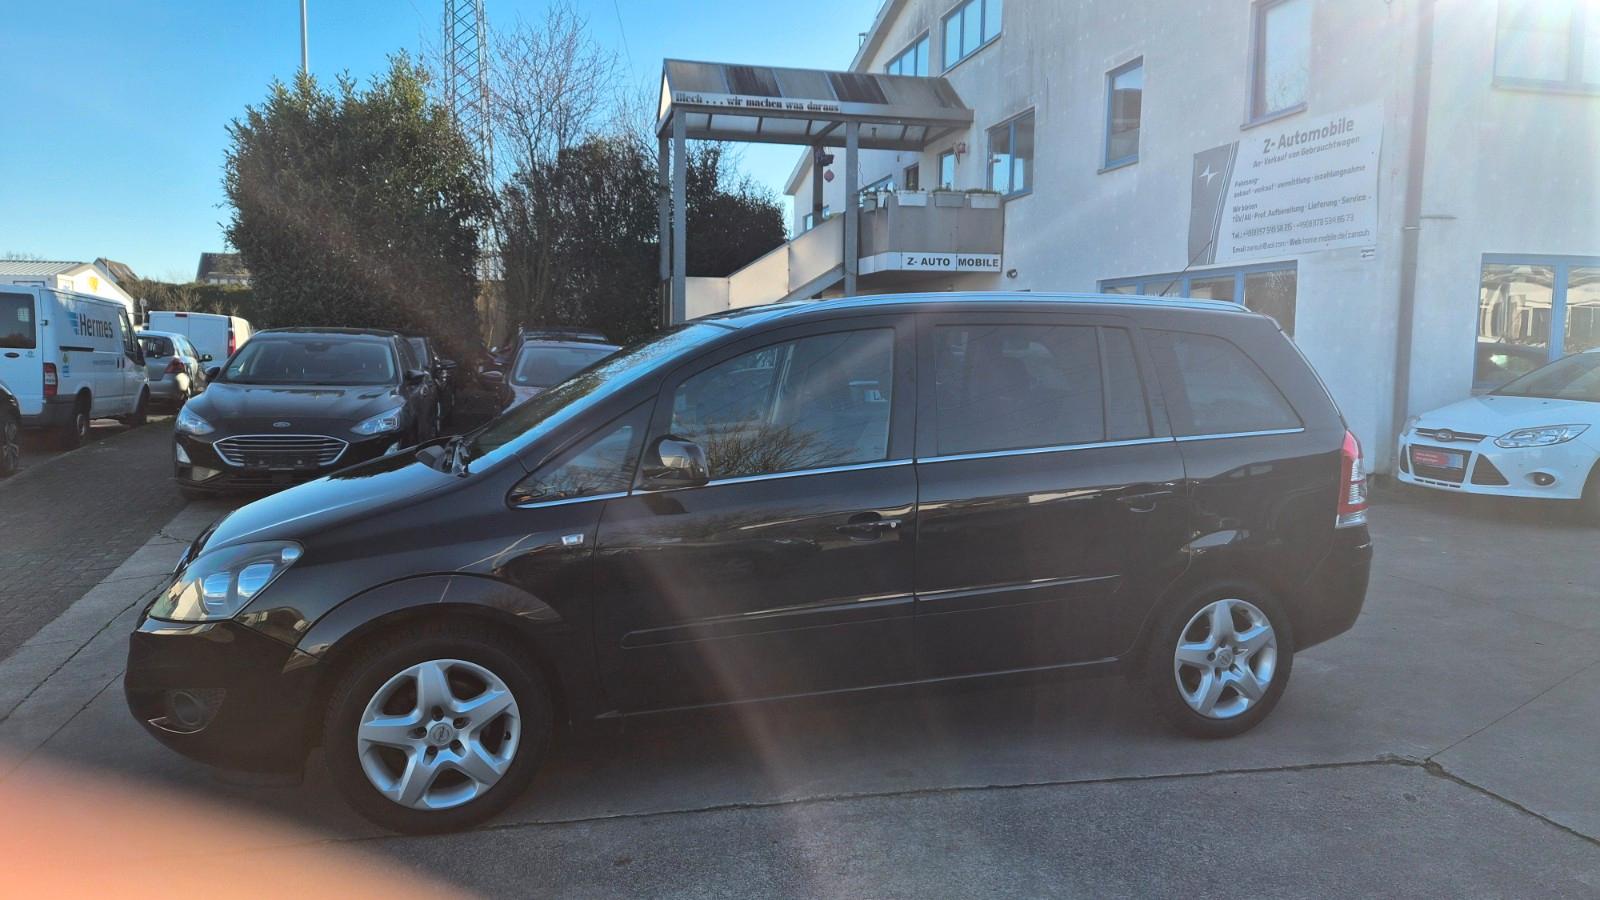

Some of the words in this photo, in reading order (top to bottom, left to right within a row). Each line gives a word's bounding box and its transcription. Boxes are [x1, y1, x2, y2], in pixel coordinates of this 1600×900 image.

[727, 96, 743, 106] wir
[746, 98, 782, 108] machen
[785, 101, 804, 110] was
[807, 101, 839, 111] daraus
[1278, 118, 1354, 148] Automobile
[1264, 152, 1288, 165] Verkauf
[1301, 137, 1360, 155] Gebrauchtwagen
[1308, 200, 1338, 210] Lieferung
[1341, 194, 1366, 204] Service
[921, 258, 950, 266] AUTO
[958, 258, 999, 267] MOBILE
[79, 313, 113, 338] Hermes
